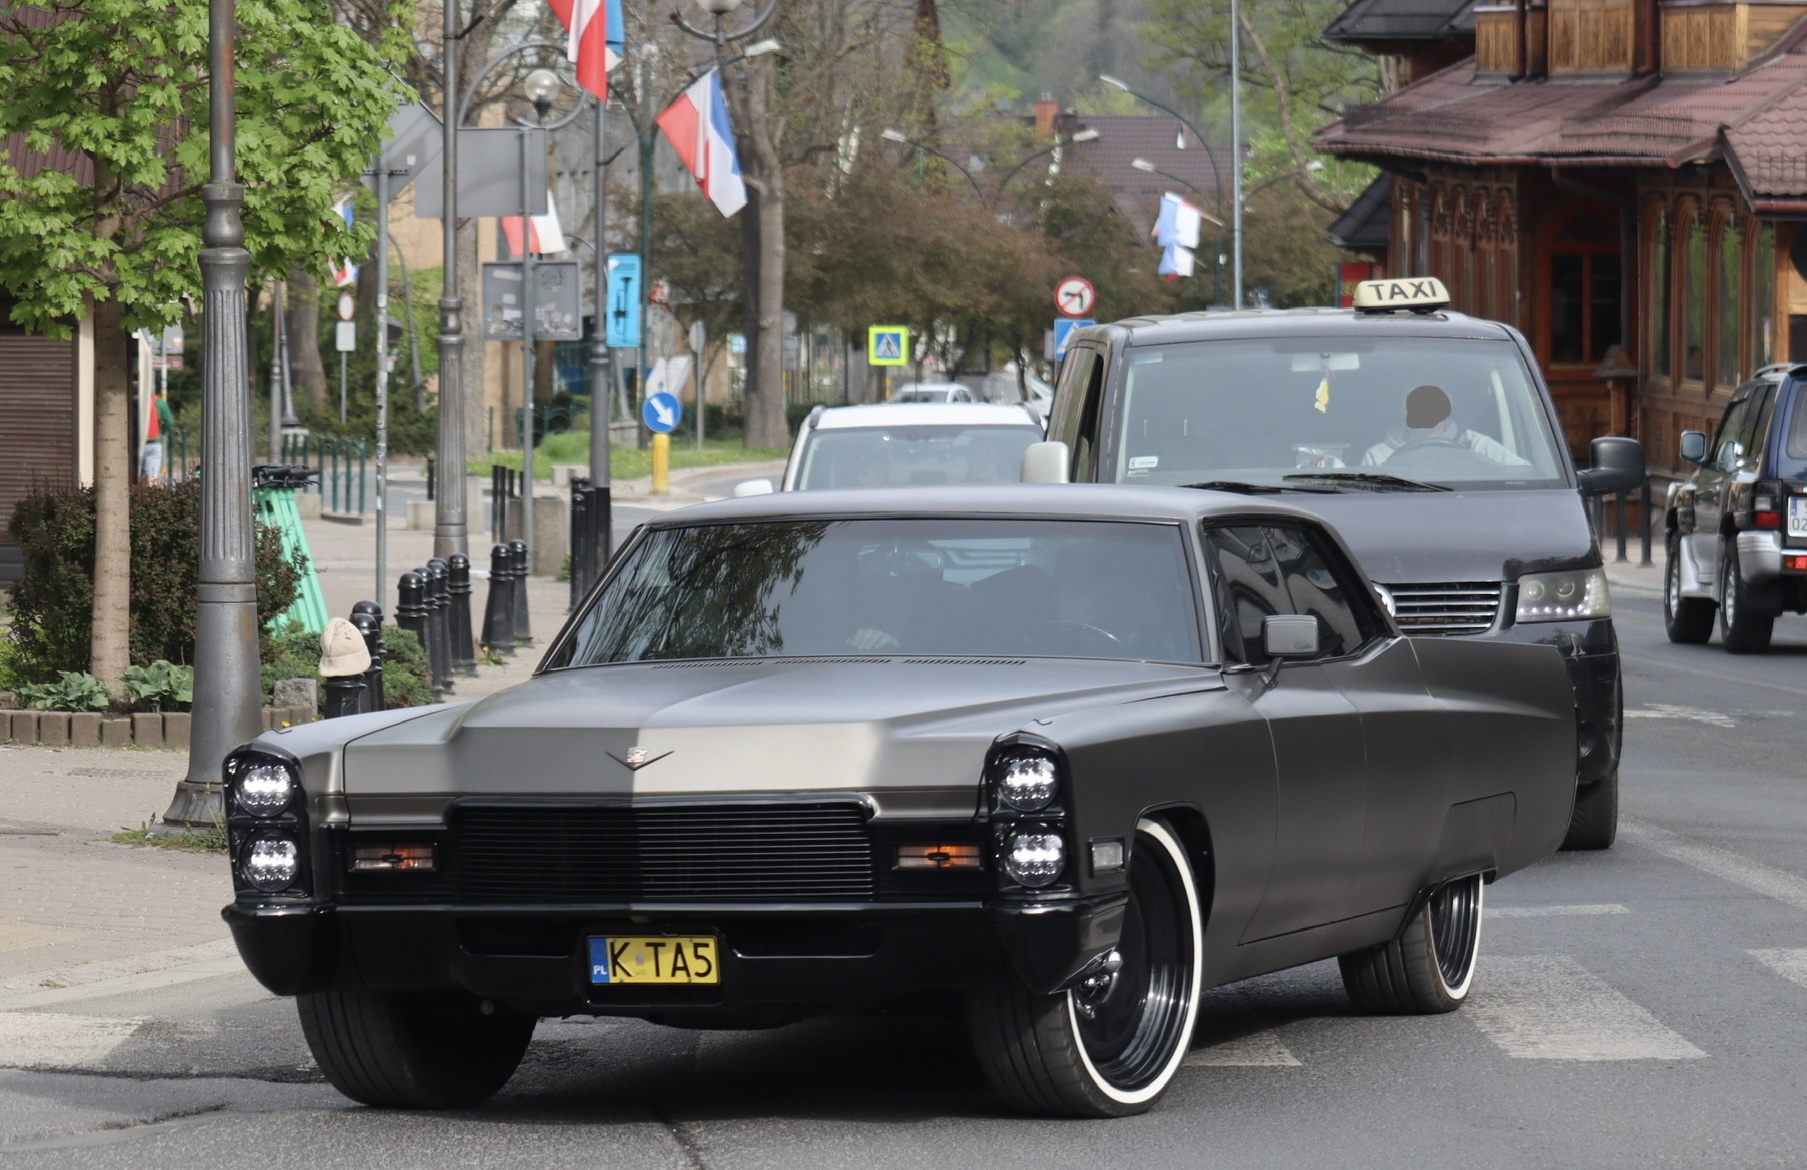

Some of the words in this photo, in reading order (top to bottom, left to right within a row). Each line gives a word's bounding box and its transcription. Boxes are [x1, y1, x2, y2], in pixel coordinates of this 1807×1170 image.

[1368, 281, 1438, 301] TAXI
[609, 941, 634, 978] K
[645, 941, 713, 978] TA5
[593, 965, 608, 976] PL
